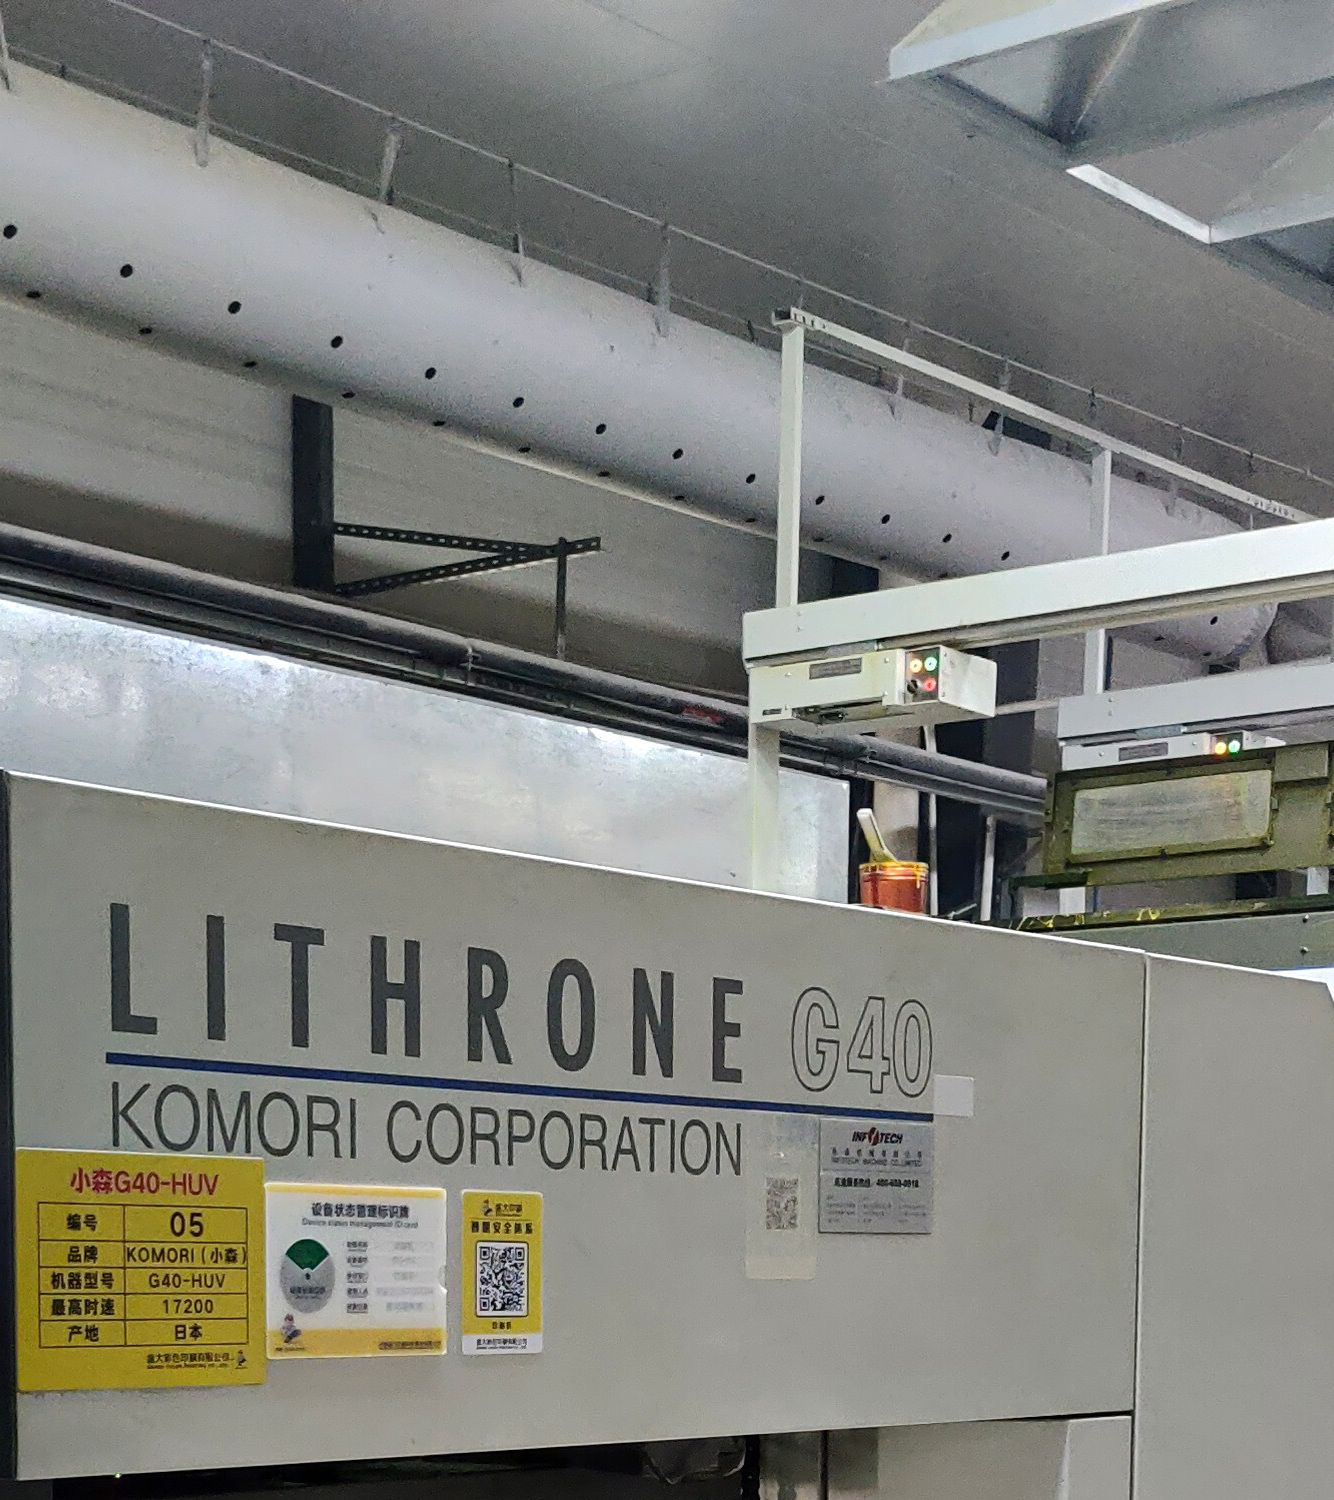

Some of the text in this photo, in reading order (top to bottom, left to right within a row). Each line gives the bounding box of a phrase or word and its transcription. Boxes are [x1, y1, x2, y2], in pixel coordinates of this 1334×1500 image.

[110, 902, 933, 1098] LITHRONE G40
[112, 1081, 742, 1177] KOMORI CORPORATION
[70, 1167, 219, 1196] 小森G40-HUV
[67, 1213, 98, 1232] 编号
[170, 1211, 204, 1238] 05
[68, 1246, 98, 1264] 品牌
[51, 1271, 115, 1290] 机器型号
[148, 1273, 226, 1289] G40-HUV
[51, 1299, 115, 1316] 最高时速
[163, 1299, 214, 1314] 17200
[68, 1325, 99, 1343] 产地
[174, 1323, 203, 1341] 日本
